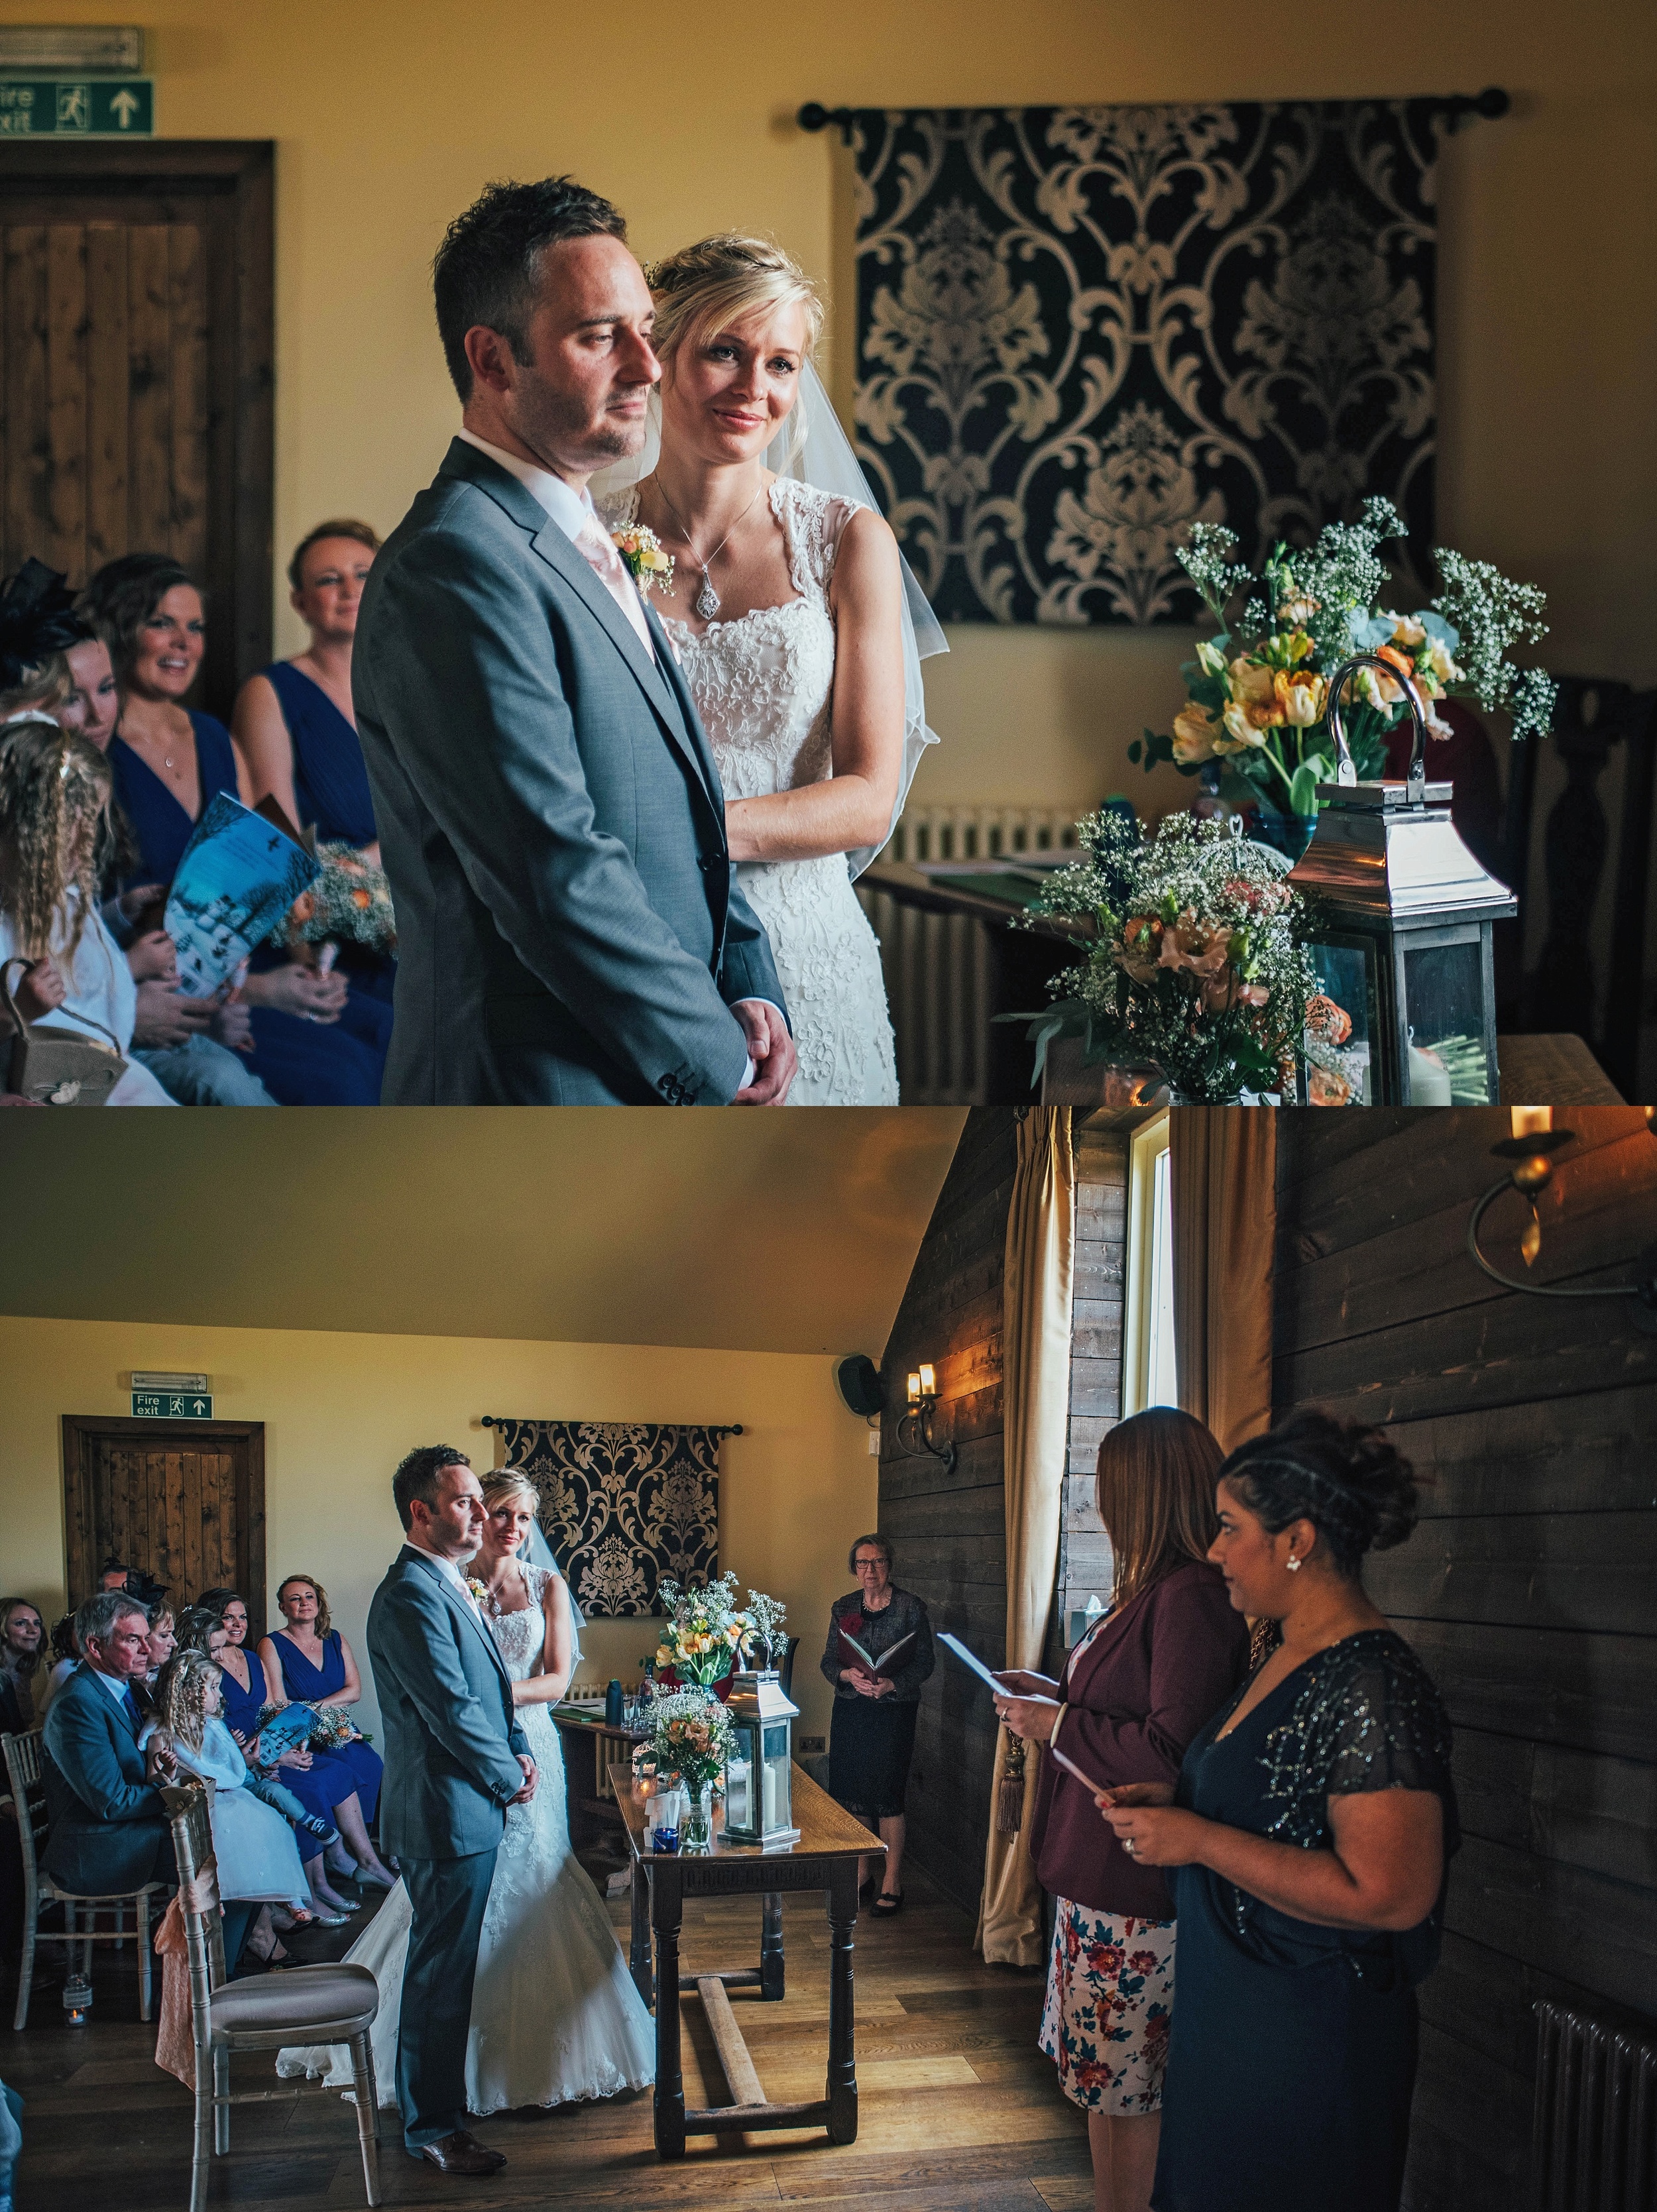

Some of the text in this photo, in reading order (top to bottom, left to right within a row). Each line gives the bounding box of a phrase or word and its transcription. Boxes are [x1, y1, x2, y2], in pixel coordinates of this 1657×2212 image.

[0, 87, 34, 107] ire
[0, 111, 31, 133] xit
[137, 1395, 160, 1405] Fire
[137, 1406, 158, 1415] exit
